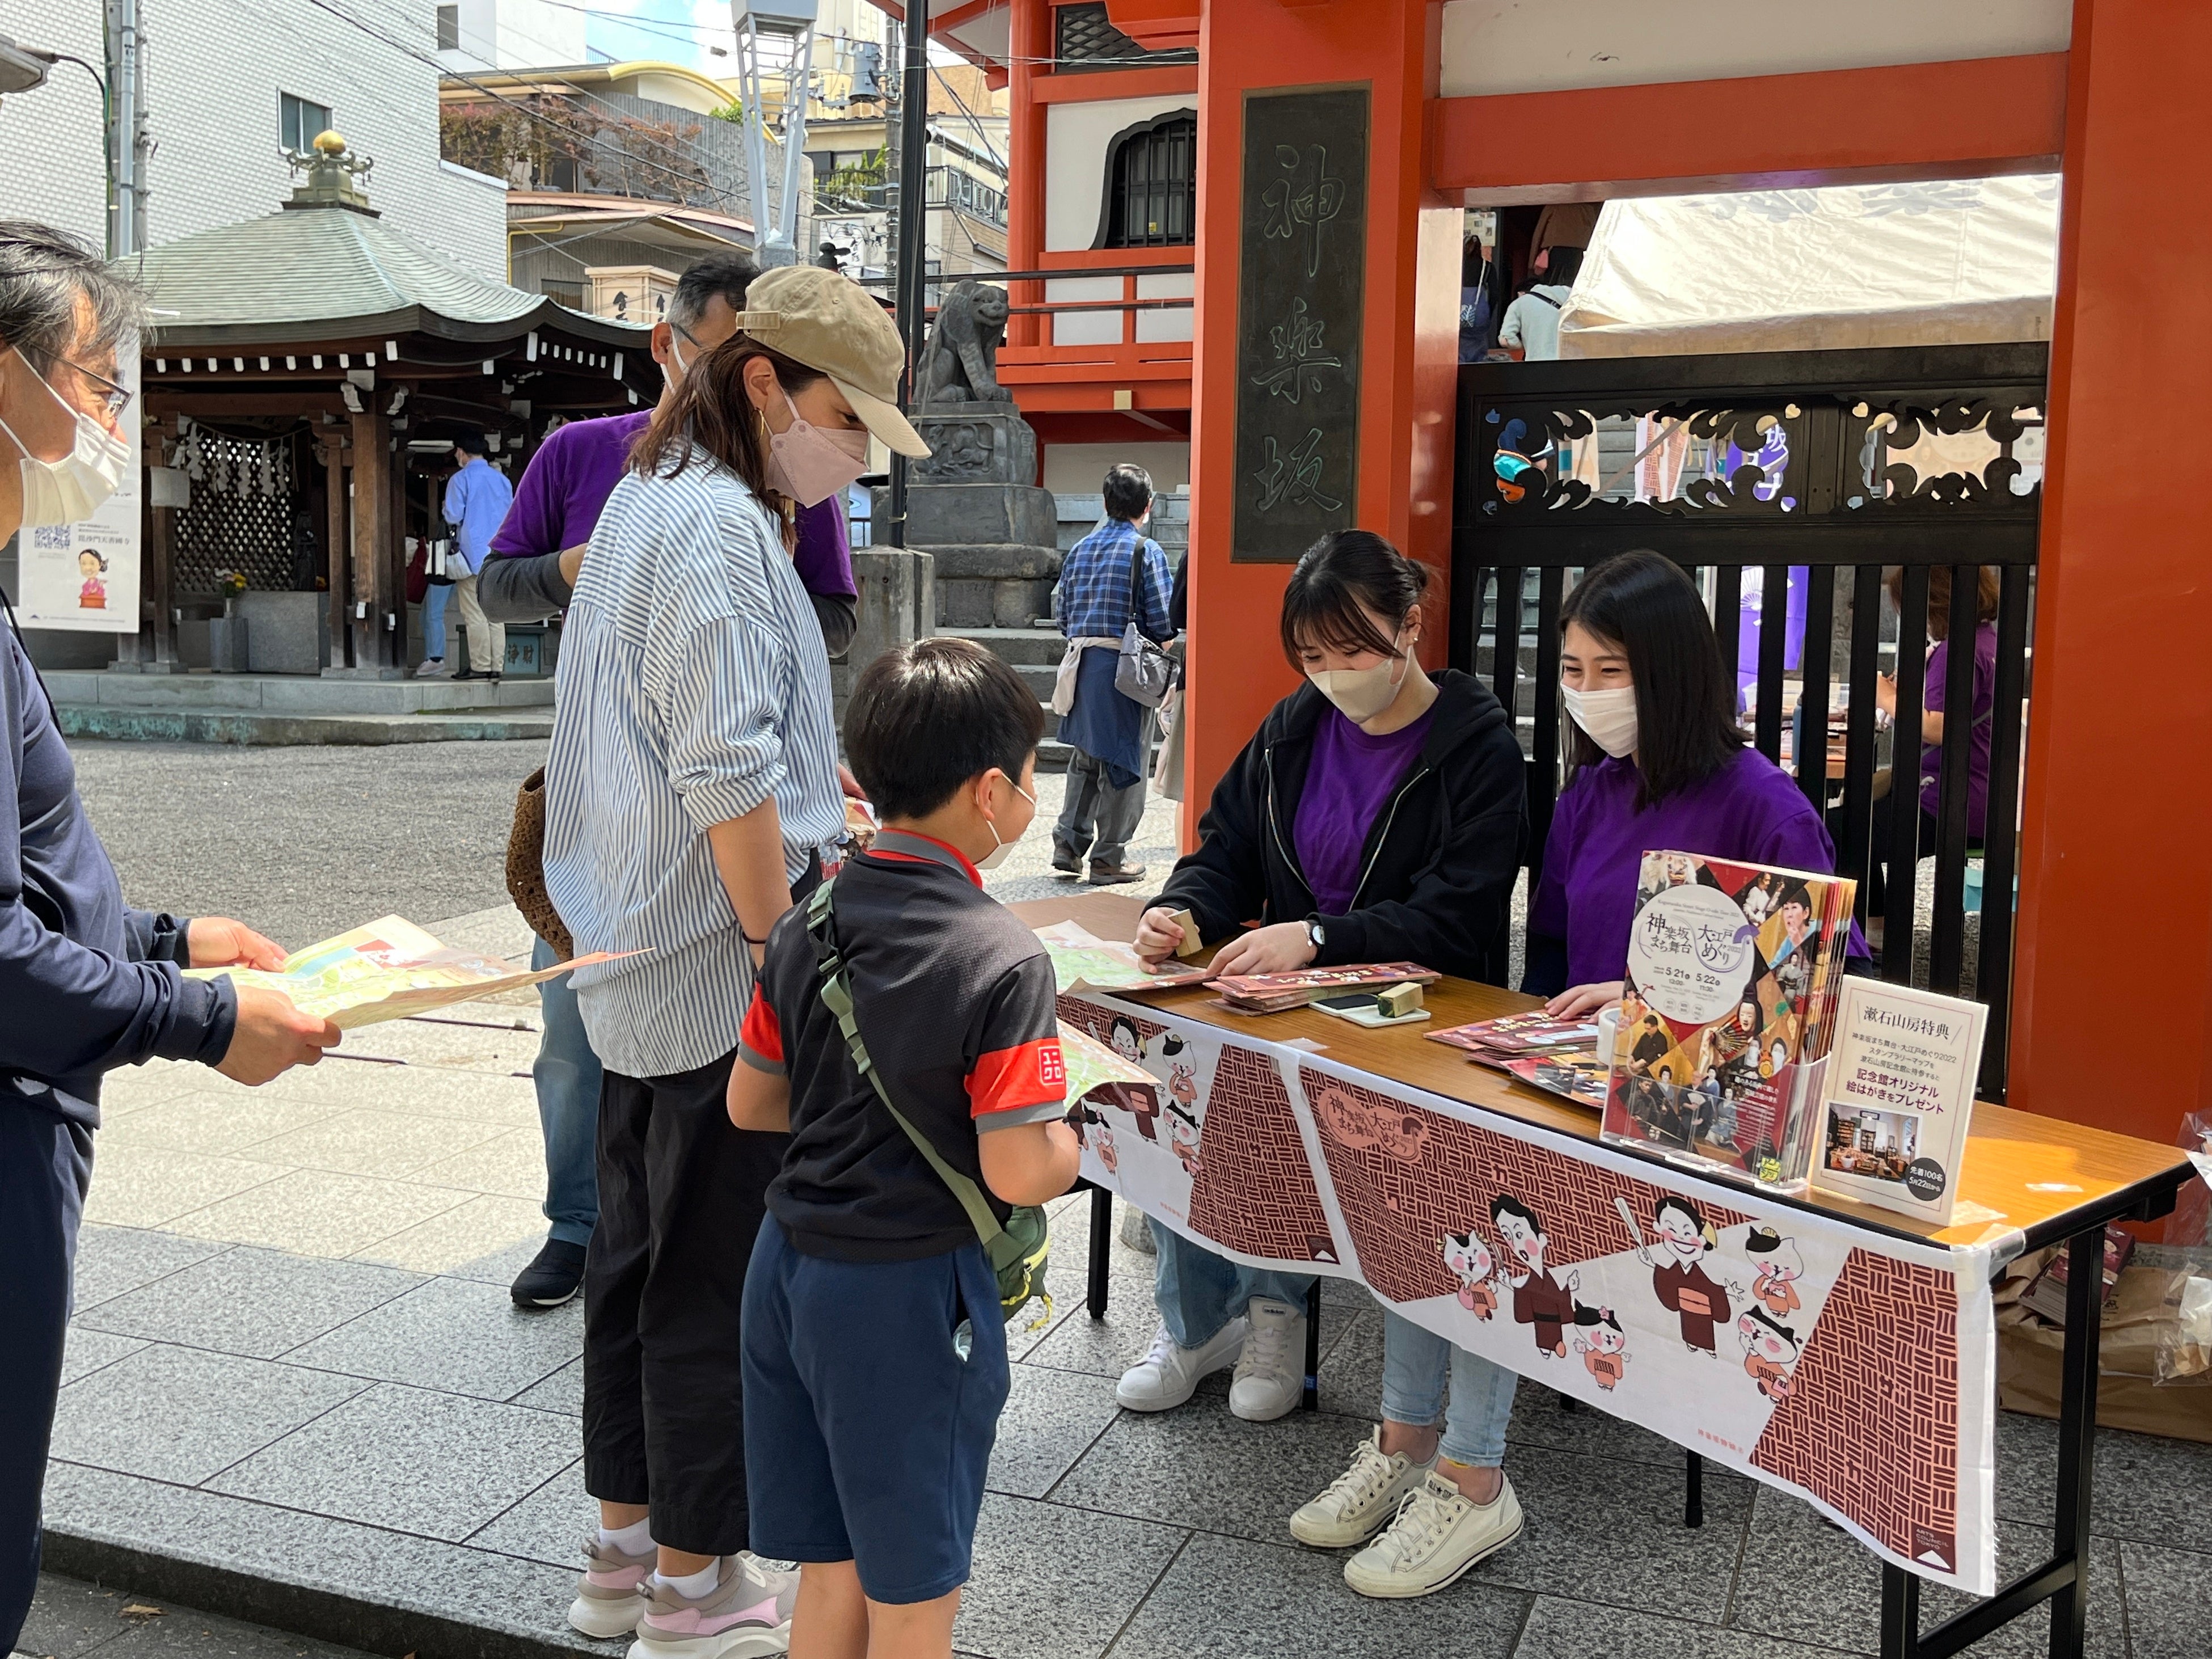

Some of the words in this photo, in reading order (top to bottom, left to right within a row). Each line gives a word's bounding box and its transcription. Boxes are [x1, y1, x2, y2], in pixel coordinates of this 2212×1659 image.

[1647, 913, 1690, 940] 神楽坂
[1650, 935, 1692, 954] まち舞台
[1702, 942, 1729, 965] めぐり
[1864, 1006, 1950, 1040] 漱石山房特典
[1869, 1048, 1934, 1069] スタンプラリーマップを
[1856, 1068, 1939, 1098] 記念館オリジナル
[1328, 1094, 1365, 1123] 神楽坂
[1846, 1080, 1944, 1115] 絵はがきをプレゼント
[1338, 1117, 1374, 1138] まち舞台
[1910, 1166, 1943, 1182] 先着100名
[1916, 1528, 1934, 1538] ARTS
[1916, 1533, 1949, 1547] COUNCIL
[1916, 1538, 1940, 1550] TOKYO
